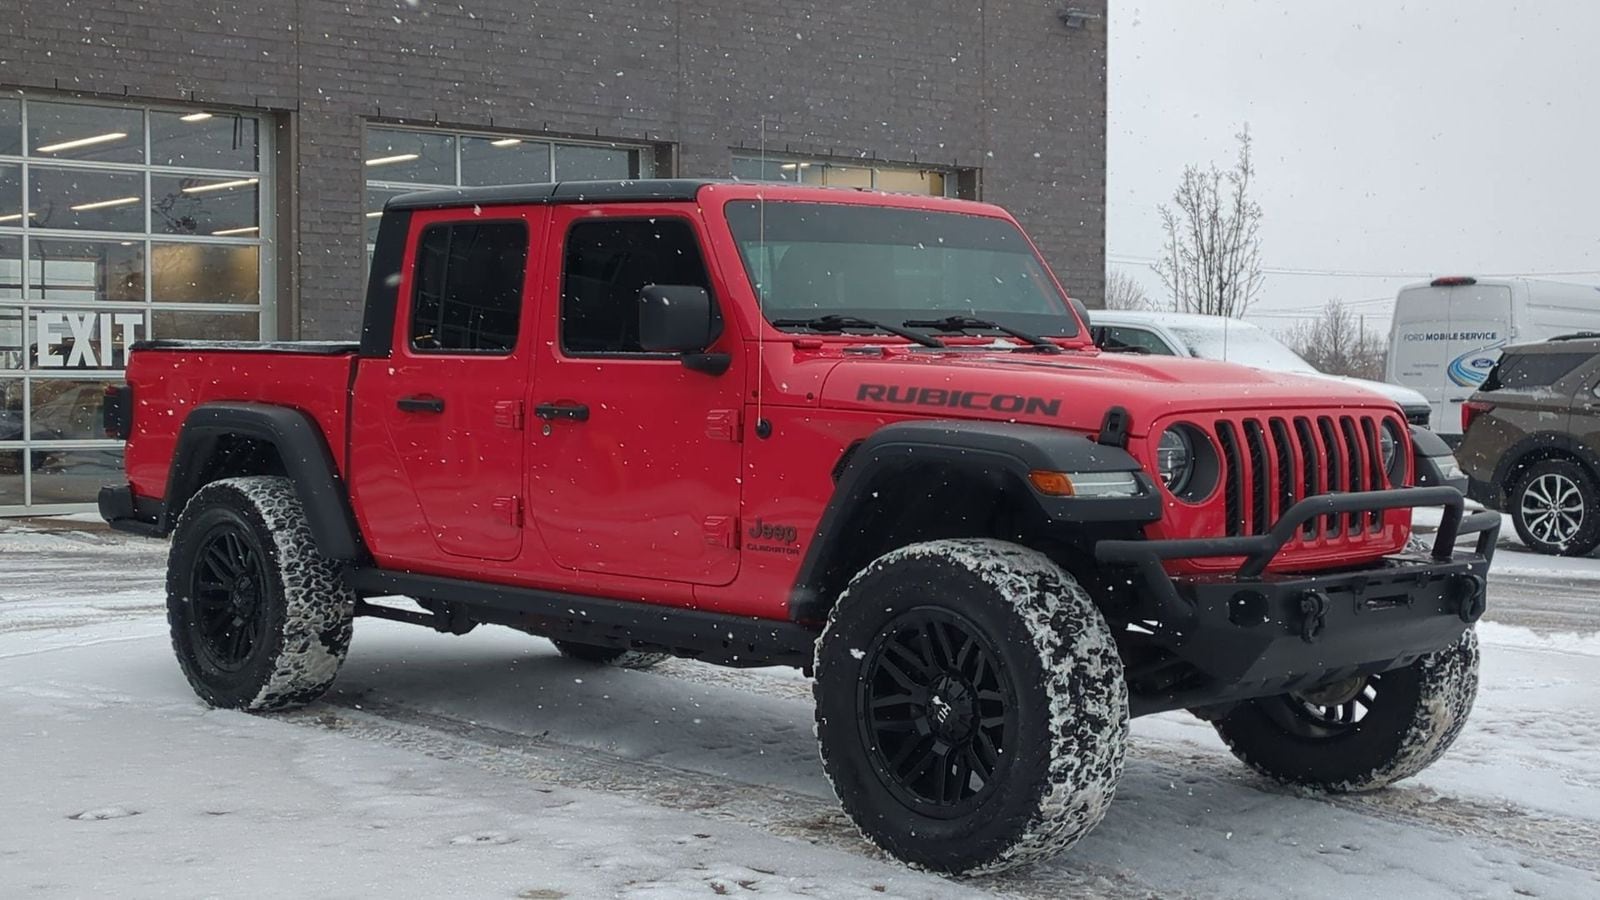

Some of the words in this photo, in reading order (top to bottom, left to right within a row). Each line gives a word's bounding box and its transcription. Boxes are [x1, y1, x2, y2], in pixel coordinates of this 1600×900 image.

[37, 313, 143, 367] EXIT
[1403, 332, 1424, 341] FORD
[1425, 332, 1458, 341] MOBILE
[1460, 332, 1496, 340] SERVICE
[856, 383, 1064, 417] RUBICON
[749, 517, 798, 546] Jeep
